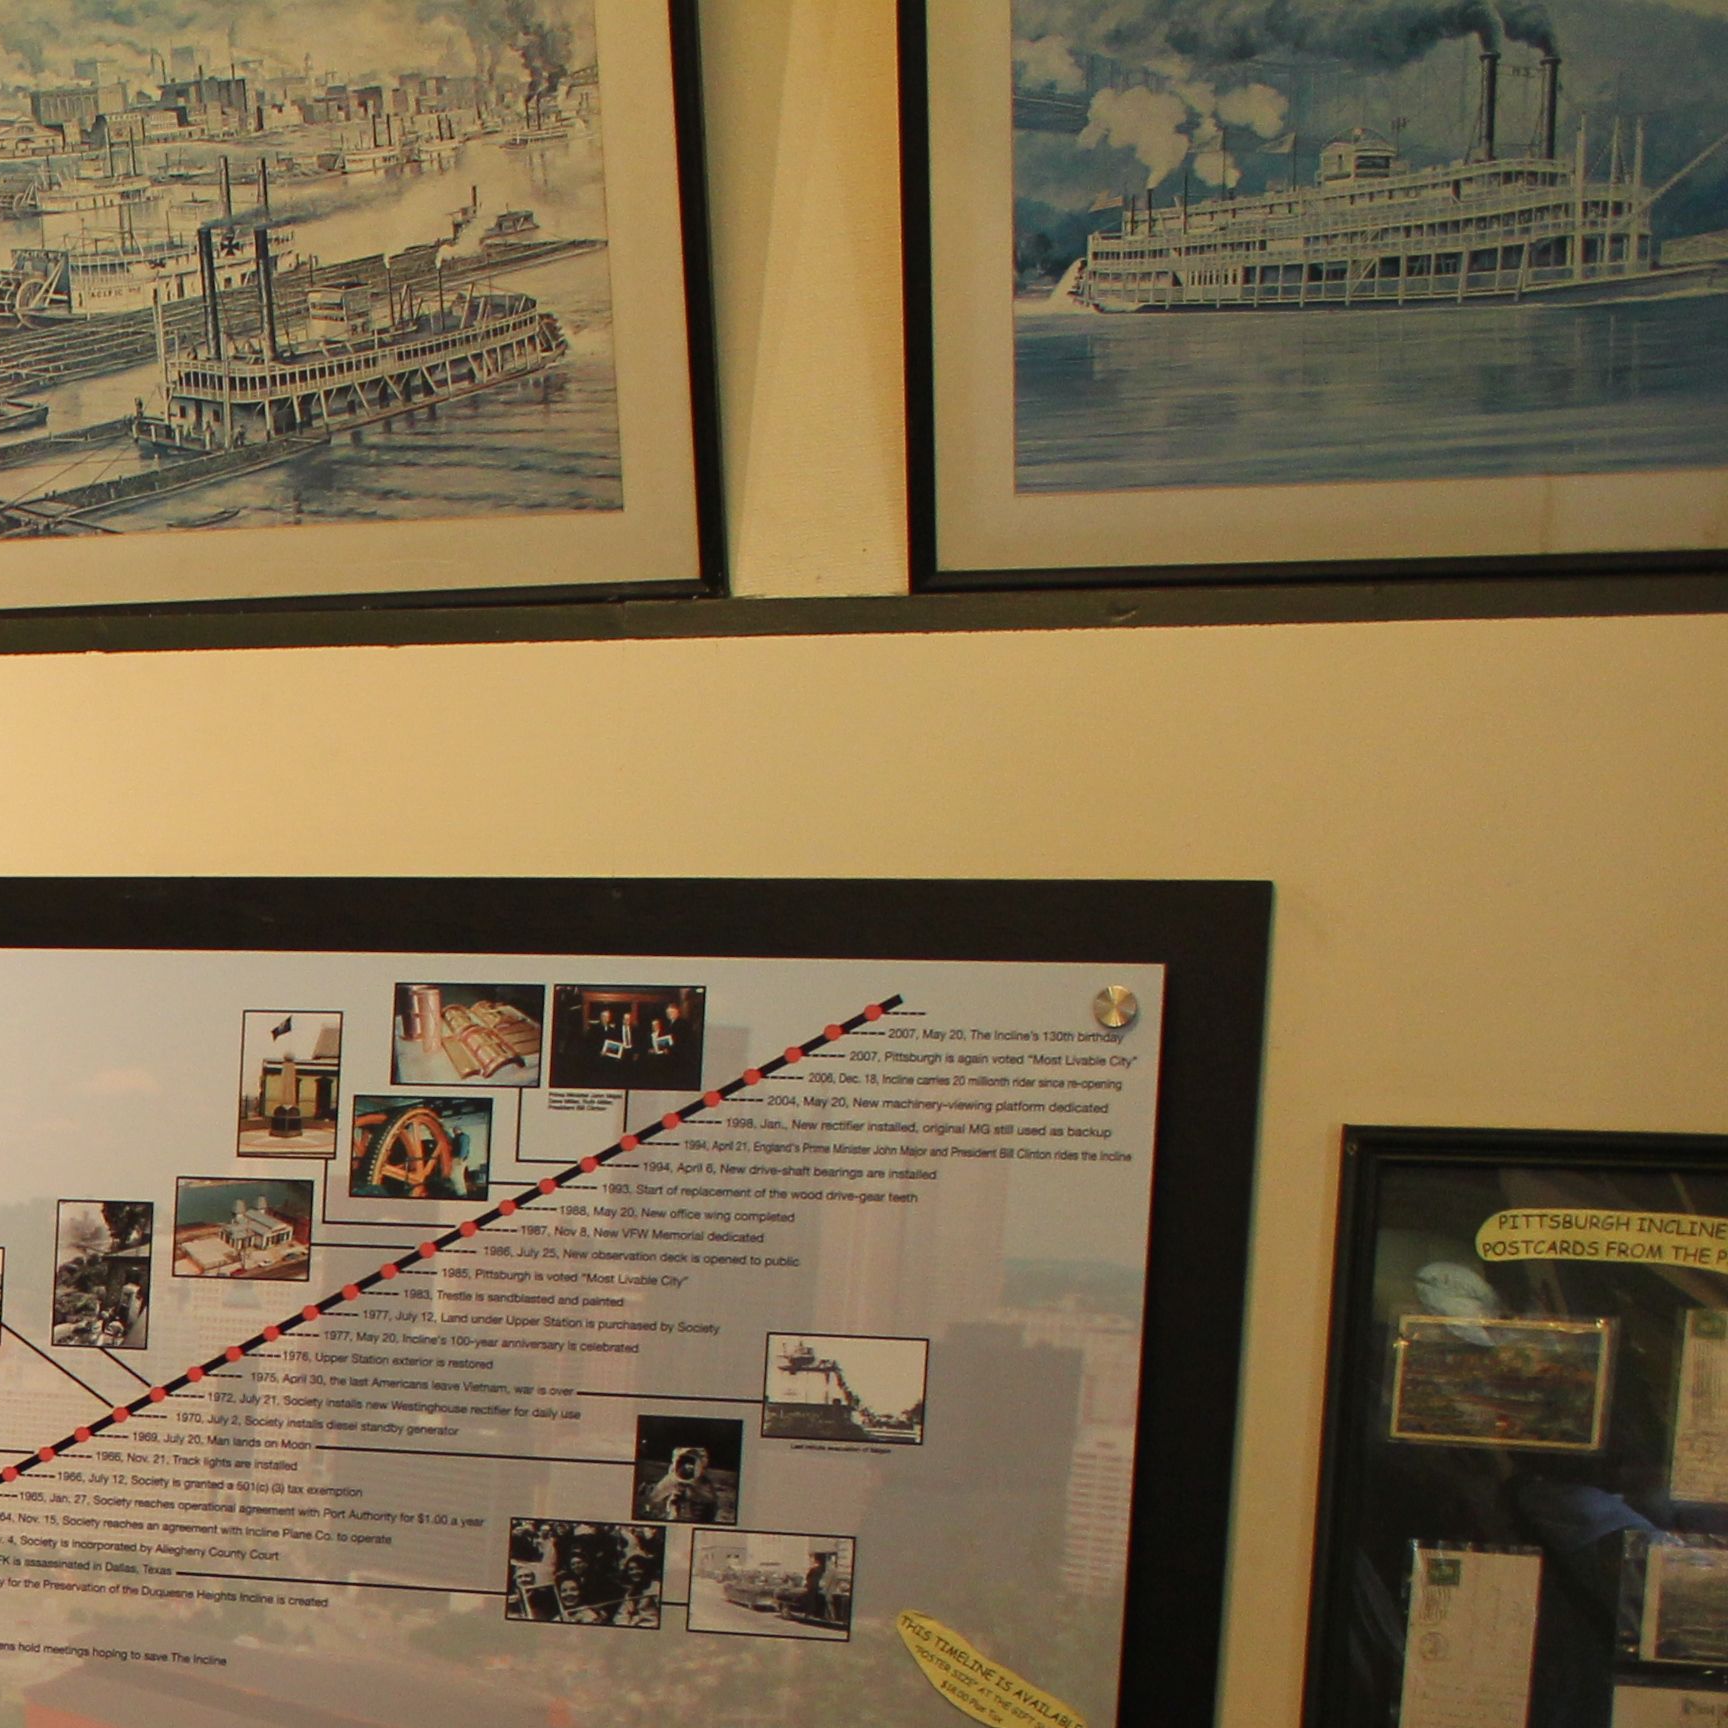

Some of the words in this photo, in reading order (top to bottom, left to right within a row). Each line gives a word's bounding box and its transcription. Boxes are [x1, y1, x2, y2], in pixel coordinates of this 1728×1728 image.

[889, 1027, 918, 1040] 2007,
[922, 1028, 946, 1042] May
[949, 1029, 966, 1040] 20,
[969, 1029, 992, 1040] The
[994, 1030, 1039, 1041] Incline's
[1043, 1031, 1074, 1042] 130th
[1077, 1029, 1124, 1045] birthday
[1498, 1214, 1630, 1232] PITTSBURGH
[1482, 1240, 1600, 1258] POSTCARDS
[1606, 1241, 1663, 1260] FROM
[1671, 1245, 1711, 1264] THE
[900, 1615, 932, 1641] THIS
[934, 1636, 997, 1681] TIMELINE
[995, 1676, 1014, 1692] IS
[978, 1686, 993, 1697] AT
[1011, 1706, 1035, 1725] GIFT
